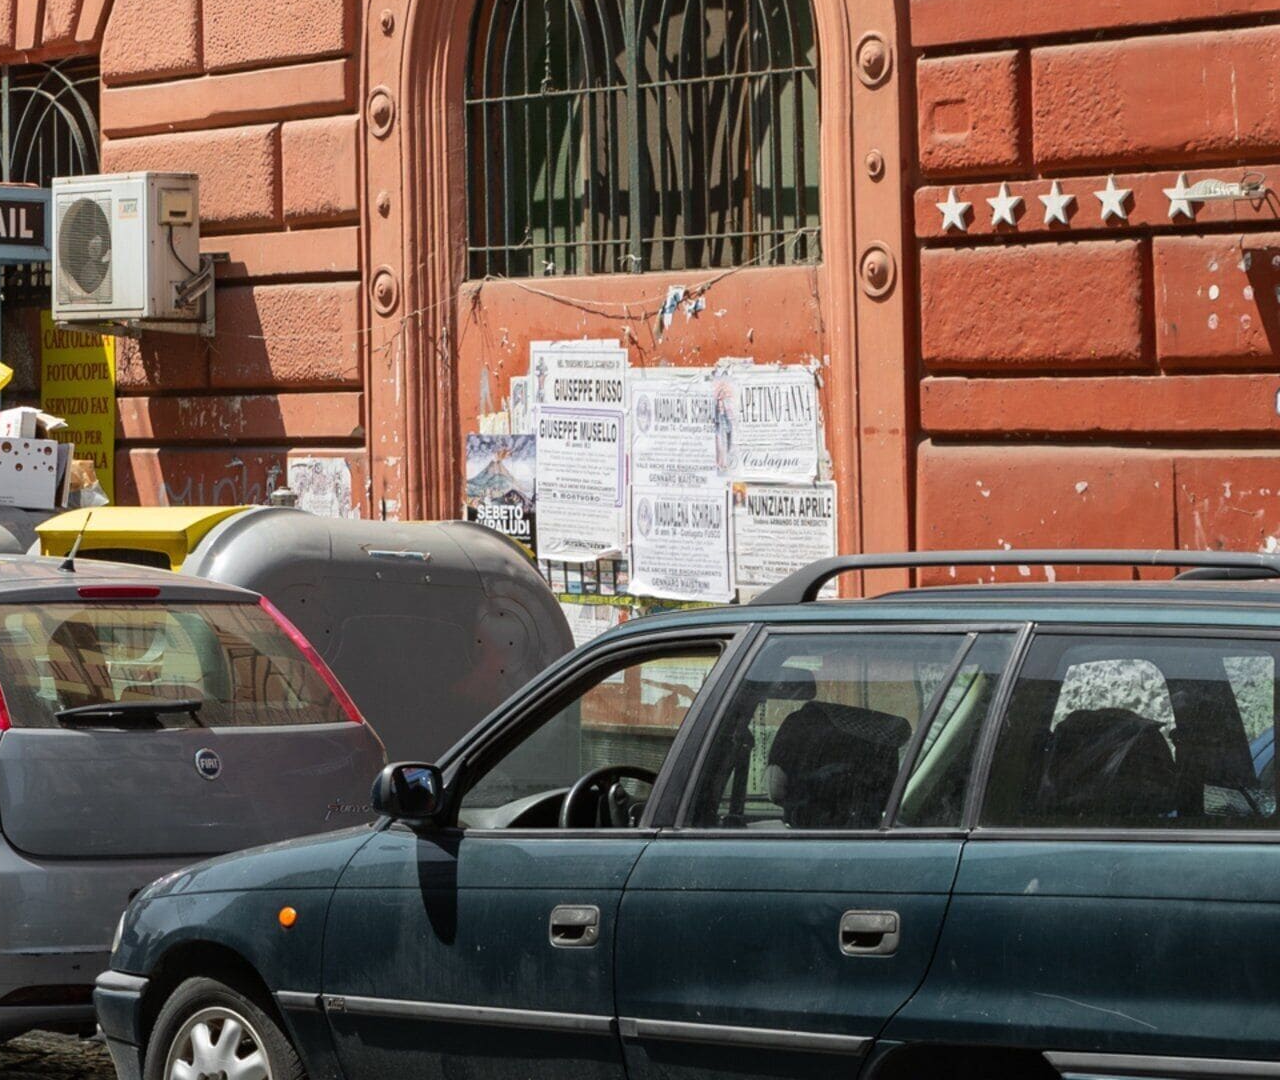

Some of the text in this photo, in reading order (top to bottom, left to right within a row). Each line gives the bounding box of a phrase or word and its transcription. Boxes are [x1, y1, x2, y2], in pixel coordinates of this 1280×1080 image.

[46, 362, 109, 382] FOTOCOPIE
[553, 378, 623, 402] GIUSEPPE RUSSO
[44, 397, 109, 415] SERVIZIO FAX
[783, 385, 813, 422] ANNA
[84, 430, 102, 445] PER
[539, 419, 617, 443] GIUSEPPE MUSELLO
[747, 495, 832, 518] NUNZIATA APRILE
